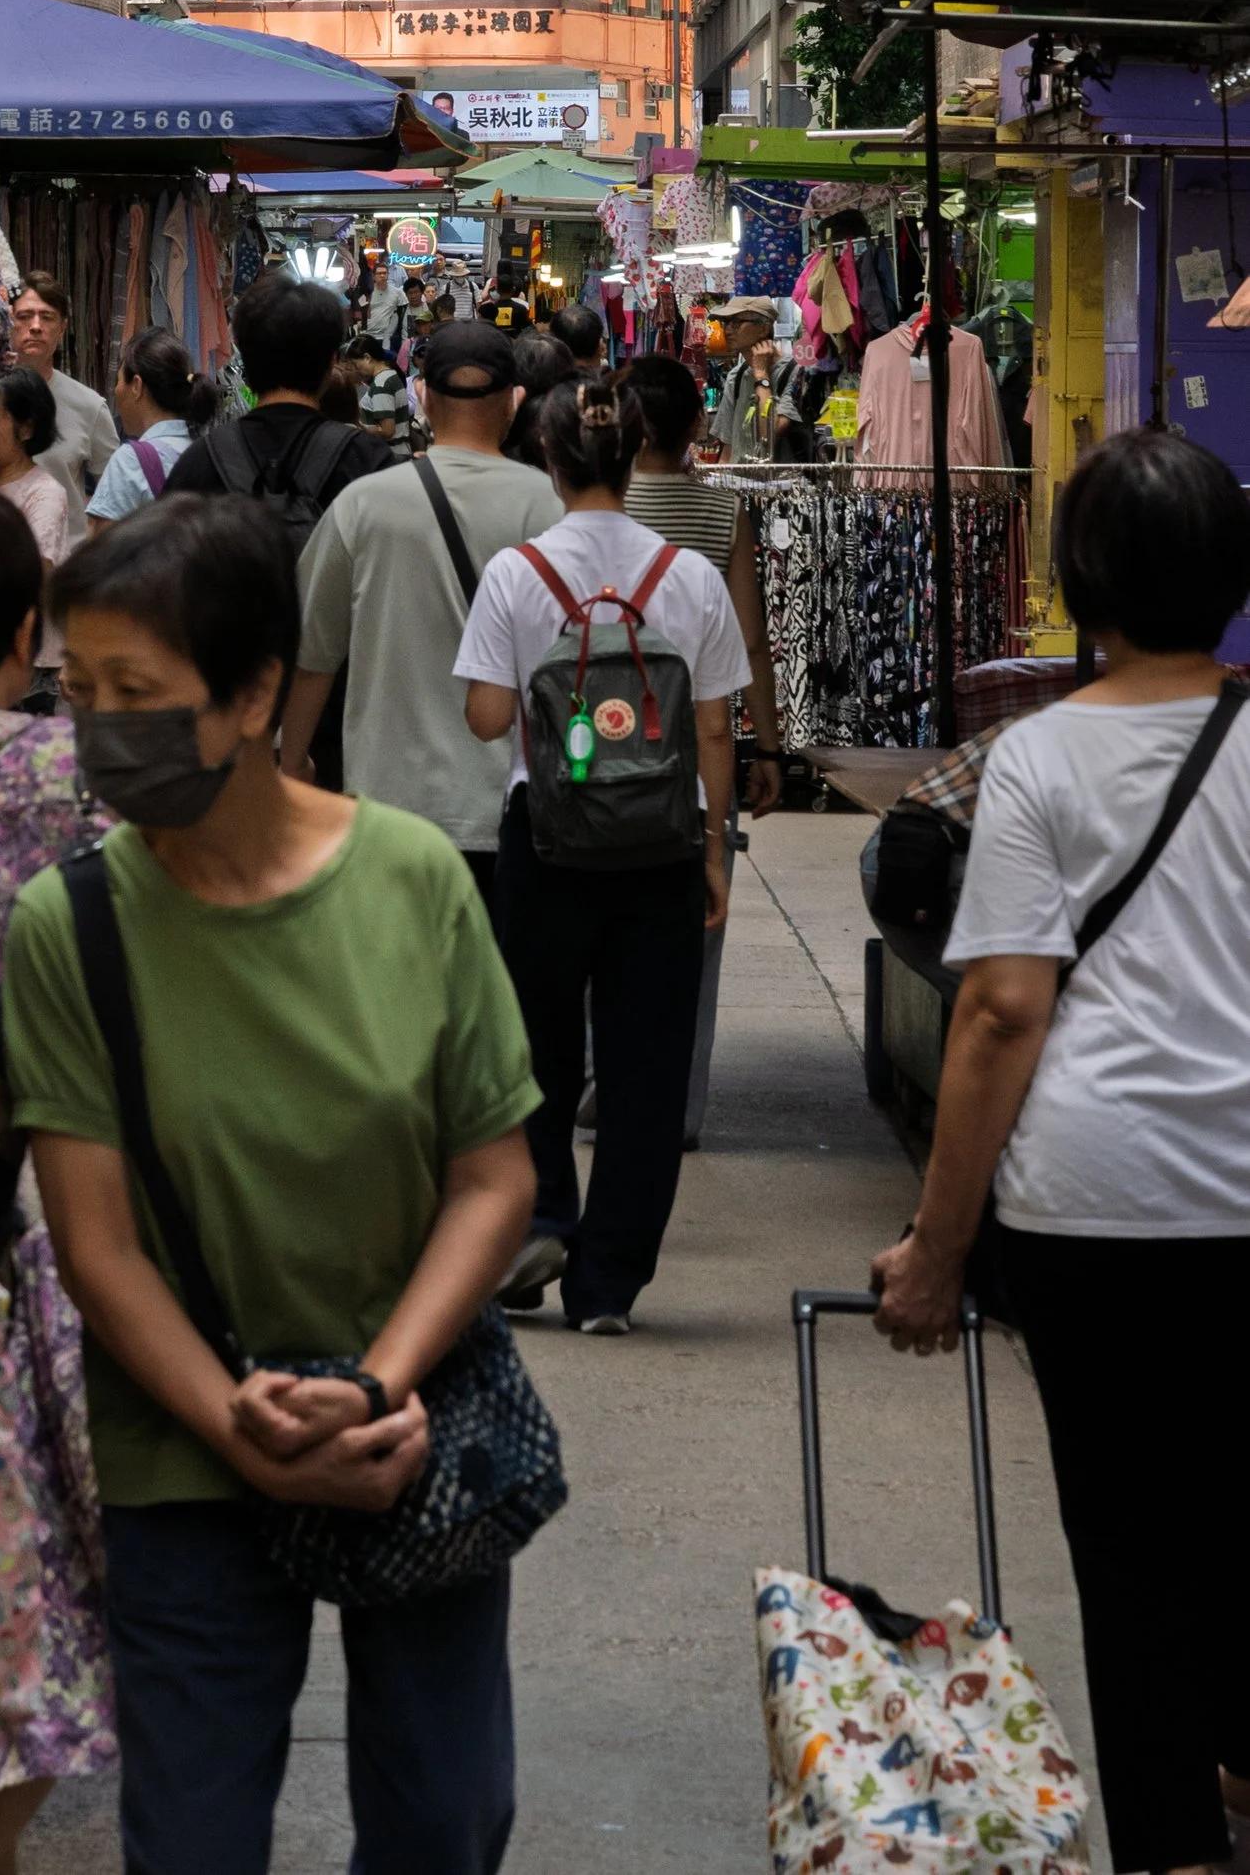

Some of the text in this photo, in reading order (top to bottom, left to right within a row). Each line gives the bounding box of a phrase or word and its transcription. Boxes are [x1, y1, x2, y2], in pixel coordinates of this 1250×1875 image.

[468, 106, 533, 129] 吳秋北
[398, 225, 429, 253] 花店
[389, 251, 437, 266] flower
[795, 345, 815, 360] 30
